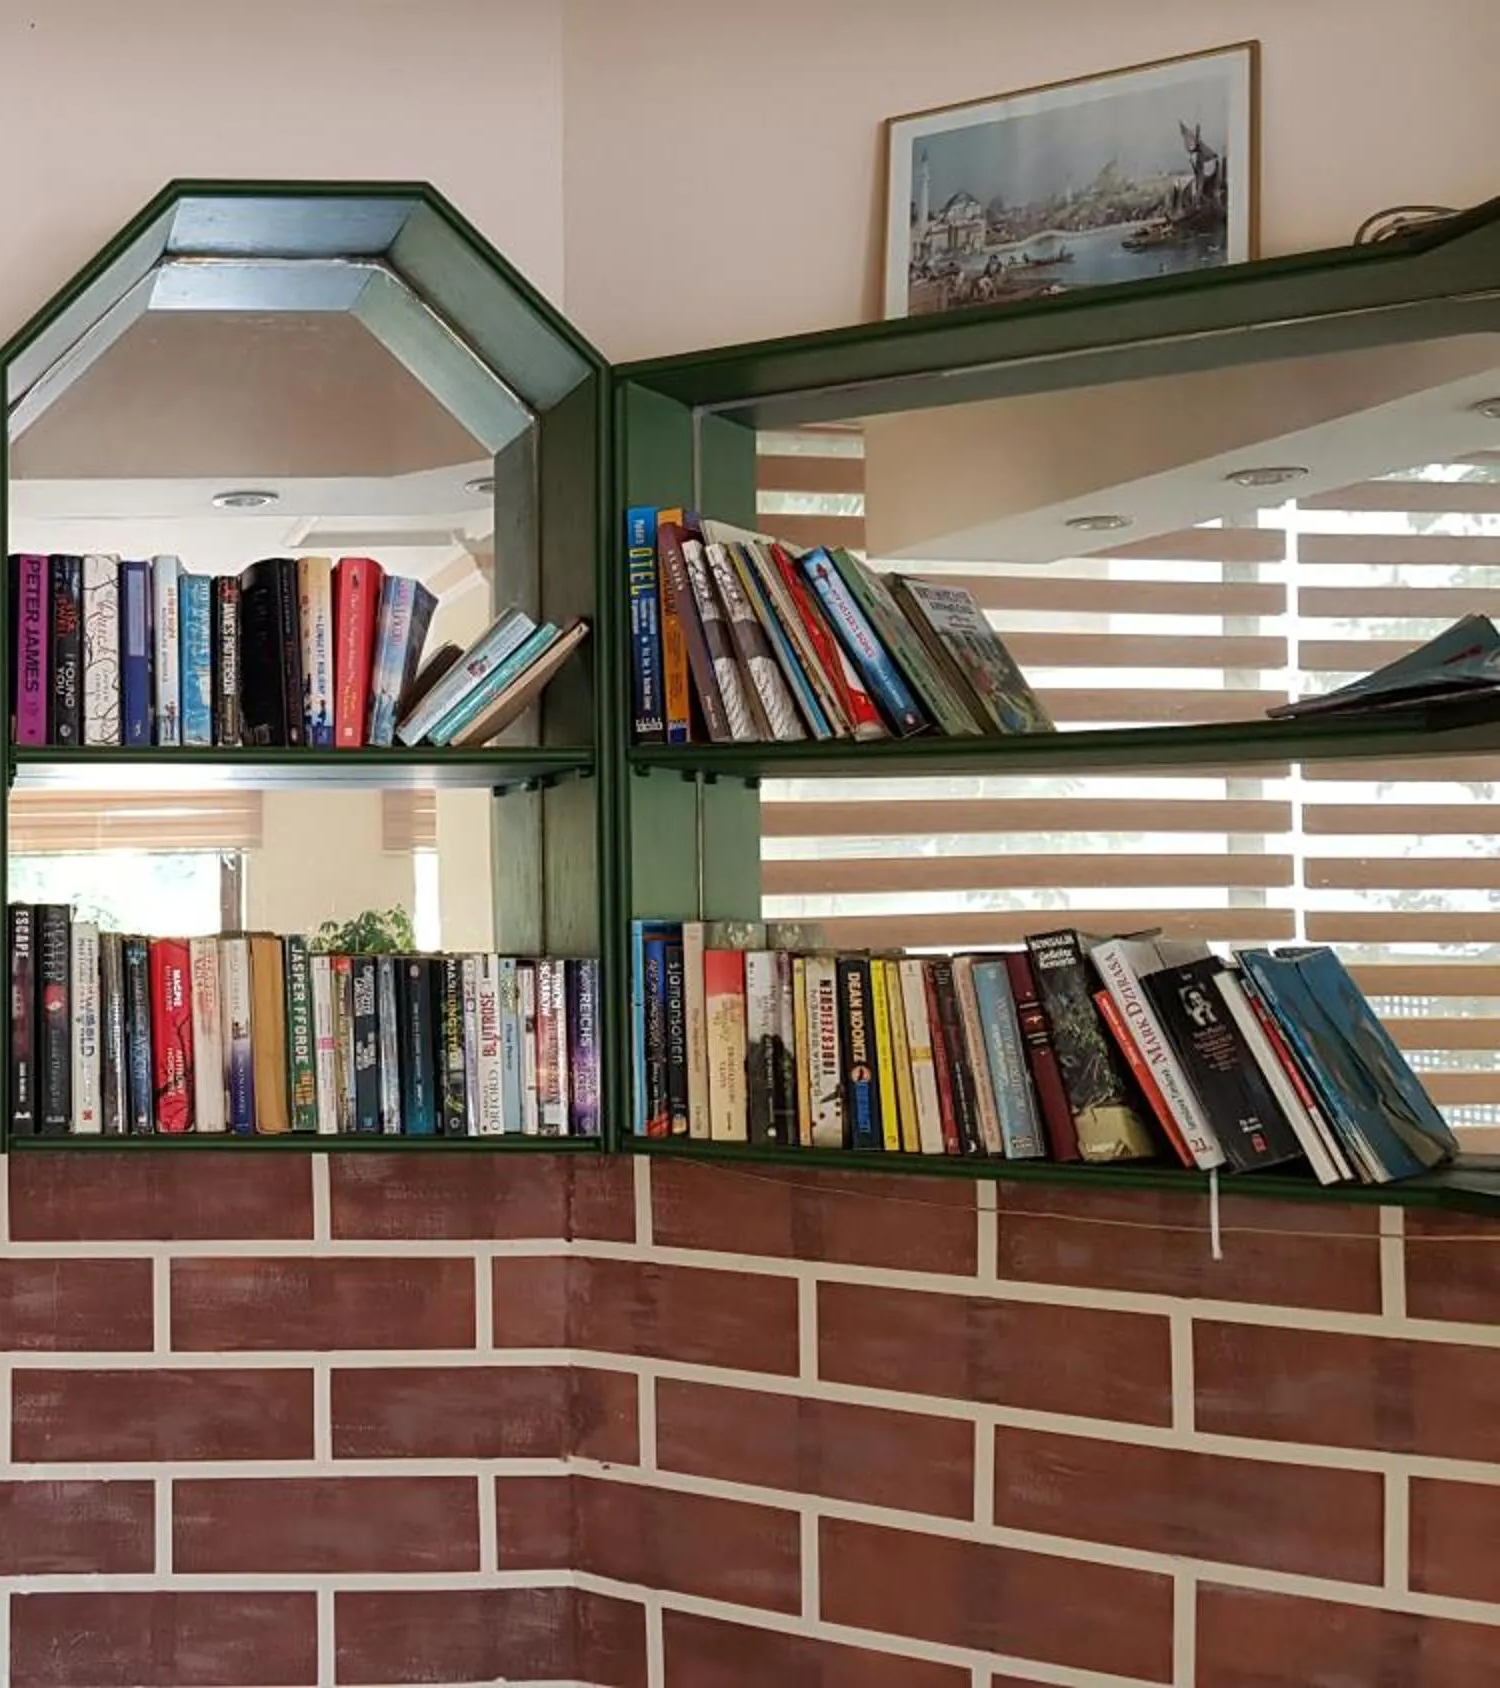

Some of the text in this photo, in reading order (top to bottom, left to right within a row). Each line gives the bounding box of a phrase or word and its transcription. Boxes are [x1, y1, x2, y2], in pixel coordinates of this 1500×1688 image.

[629, 547, 655, 596] OTEL
[25, 560, 41, 692] PETER JAMES
[223, 603, 235, 695] JAMES PATTERSON
[56, 666, 66, 694] YOU
[65, 661, 75, 708] FOUND
[14, 910, 30, 958] ESCAPE
[173, 969, 183, 1008] MAGPIE
[292, 945, 305, 1001] JASPER
[540, 965, 551, 1017] SCARROW
[551, 973, 562, 1010] SIMON
[847, 972, 861, 1007] DEAN
[294, 1007, 309, 1065] FFORDE
[480, 992, 497, 1057] BLUTROSE
[580, 994, 592, 1047] REICHS
[668, 961, 684, 1065] sjamansonen
[819, 979, 836, 1076] TODESZEICHEN
[850, 1010, 866, 1063] KOONTZ
